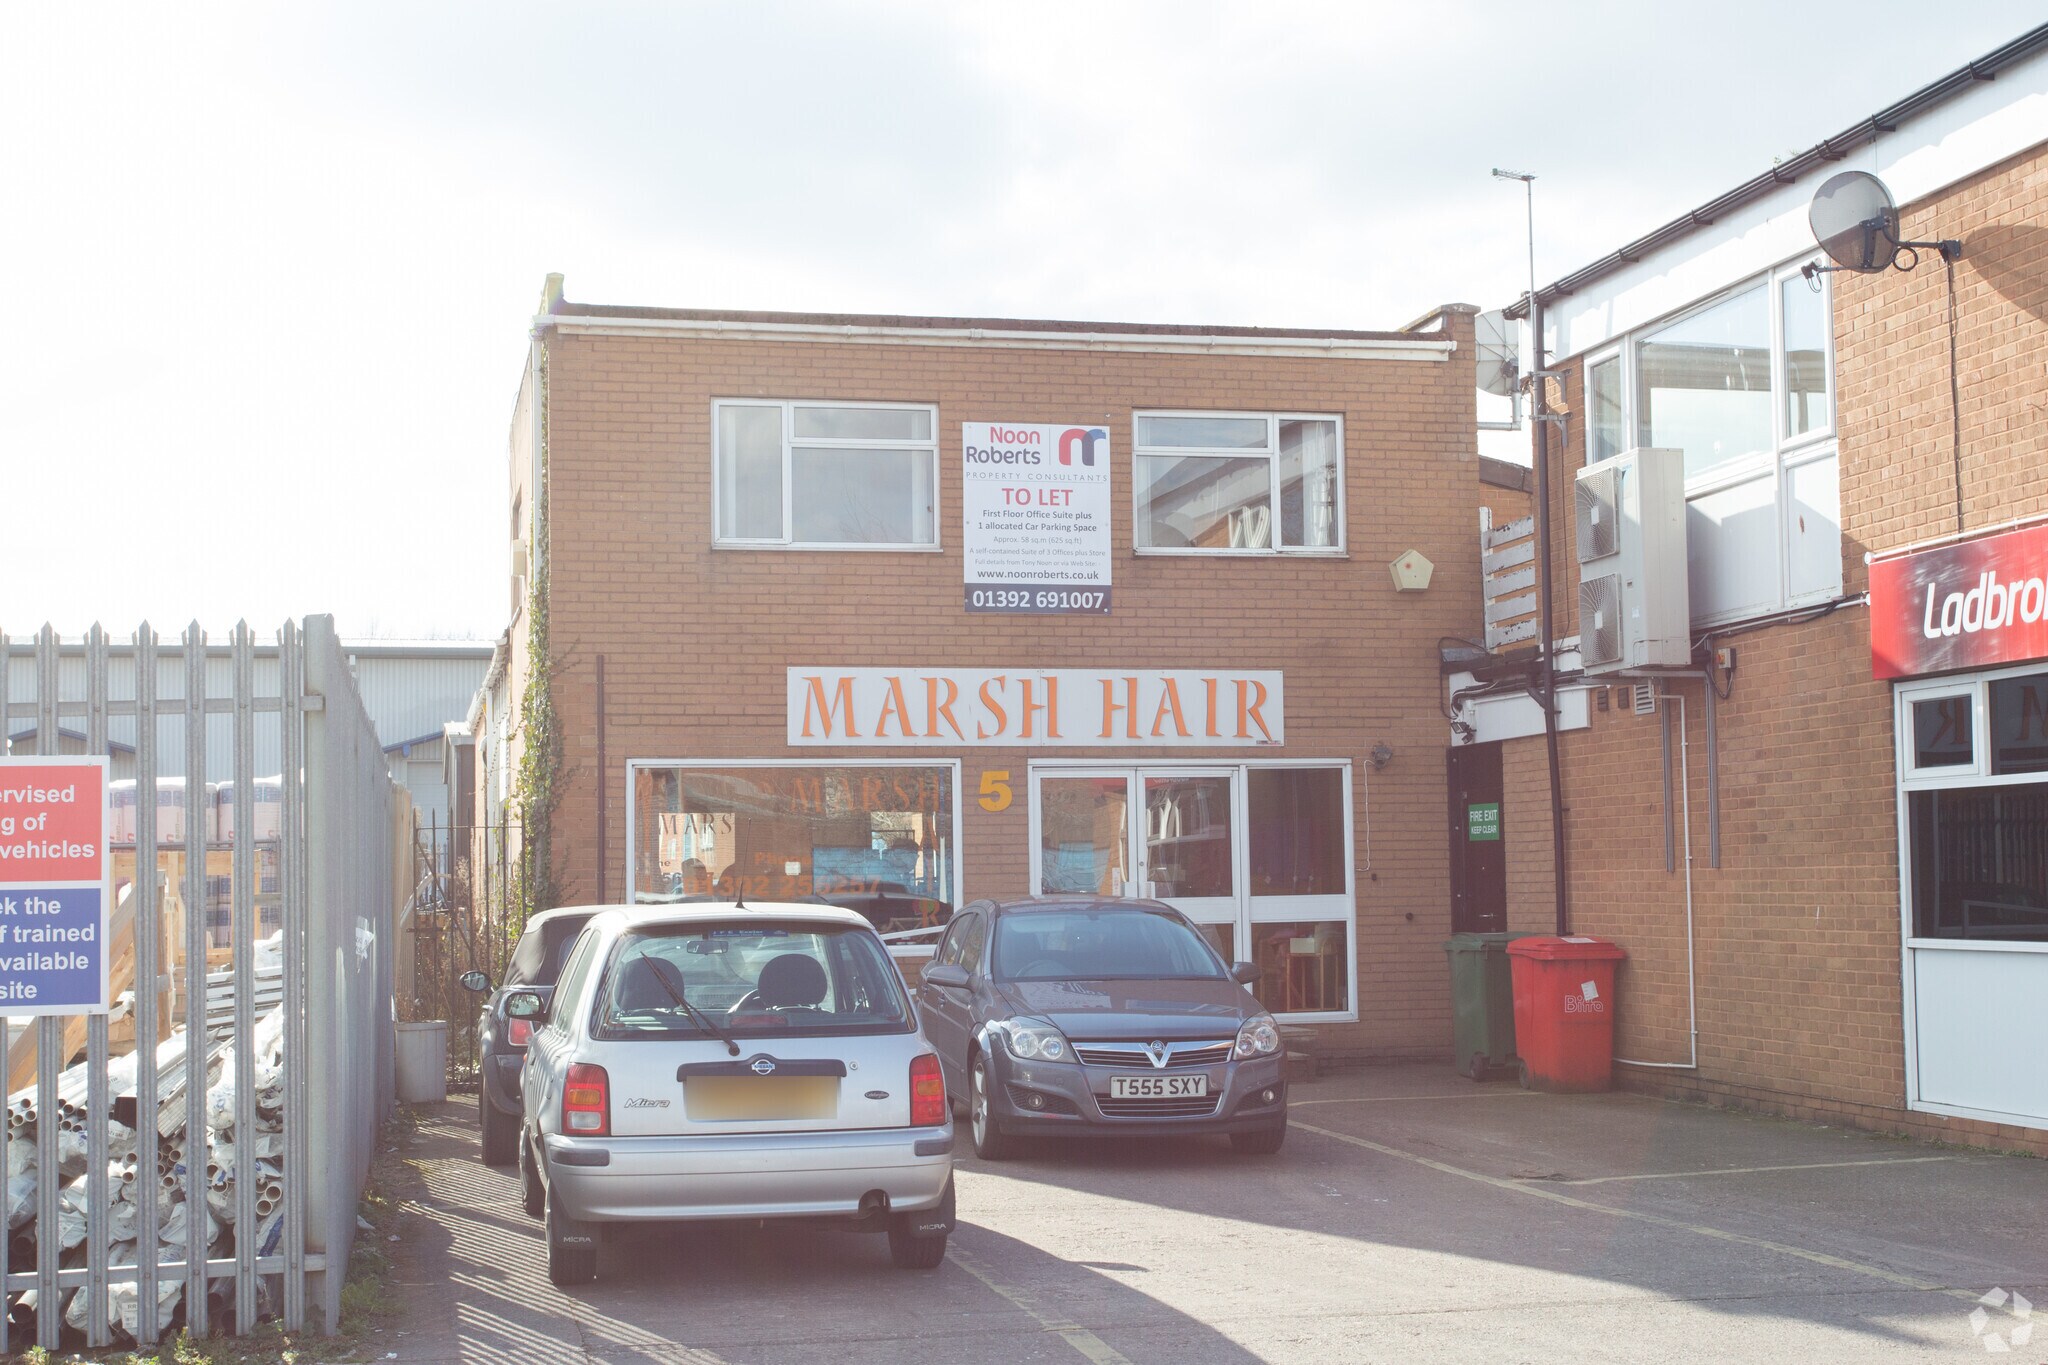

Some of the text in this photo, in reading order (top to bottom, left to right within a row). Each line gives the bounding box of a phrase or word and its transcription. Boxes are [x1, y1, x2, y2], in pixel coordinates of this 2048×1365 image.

[990, 426, 1040, 445] Noon
[966, 446, 1041, 465] Roberts
[966, 471, 1108, 482] PROPERTY CONSULTANTS
[1001, 487, 1073, 506] TO LET
[982, 509, 1092, 521] First Floor Office Suite plus
[978, 522, 1097, 534] 1 allocated Car Parking Space
[994, 536, 1018, 545] Approx.
[1048, 537, 1063, 545] (625
[976, 547, 1020, 555] self-contained
[1075, 549, 1088, 557] plus
[1088, 549, 1106, 557] Store
[977, 569, 1099, 581] www.noonroberts.co.uk
[972, 590, 1104, 609] 01392 691007
[1924, 570, 2048, 639] Ladbro
[801, 674, 1273, 742] MARSH HAIR
[0, 785, 75, 804] rvised
[789, 774, 942, 815] MARSH
[978, 770, 1013, 812] 5
[23, 812, 47, 831] of
[1469, 809, 1498, 822] FIRE EXIT
[1471, 825, 1497, 834] KEEP CLEAR
[0, 840, 95, 859] vehicles
[682, 875, 768, 897] 01392
[0, 896, 61, 915] k the
[13, 923, 95, 943] trained
[1116, 1078, 1202, 1096] T555 SXY
[624, 1097, 671, 1108] Micra
[919, 1223, 947, 1231] MICRA
[563, 1235, 592, 1243] MICRA
